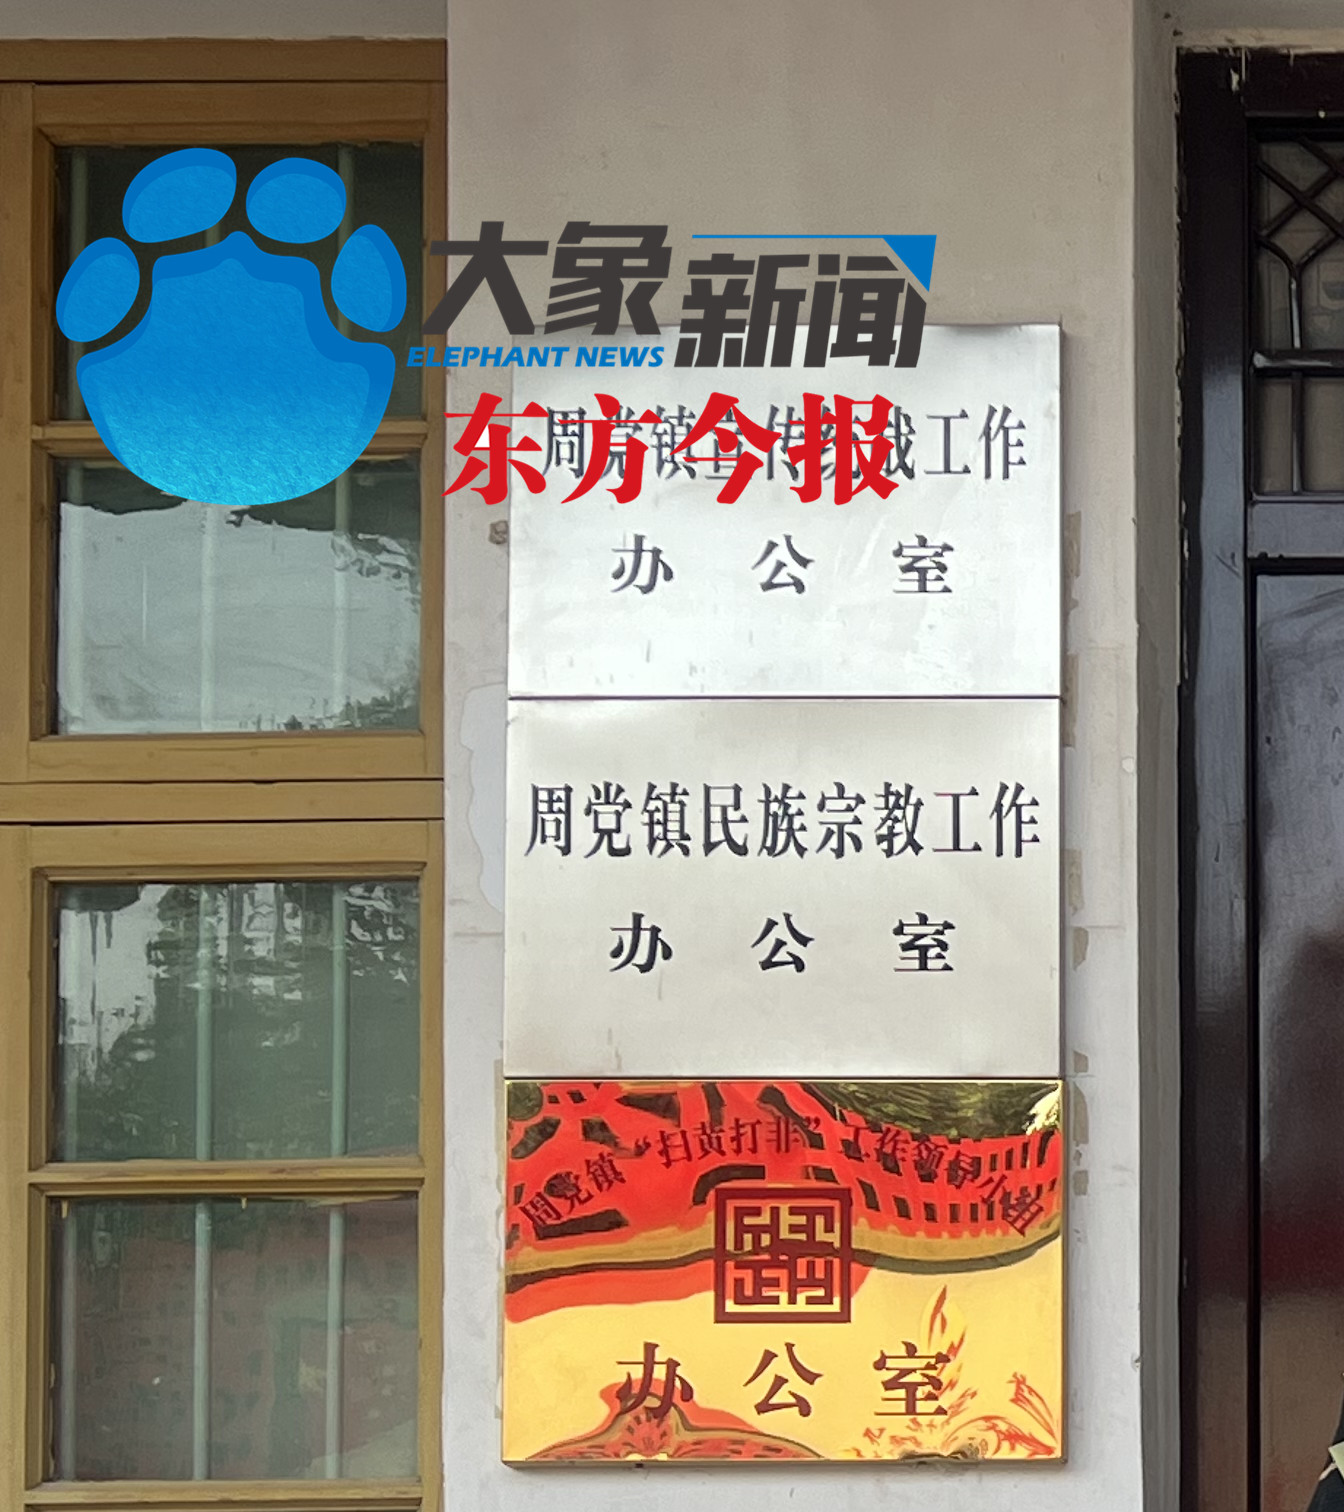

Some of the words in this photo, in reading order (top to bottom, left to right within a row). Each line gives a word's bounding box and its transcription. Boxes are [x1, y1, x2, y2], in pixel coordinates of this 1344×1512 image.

[611, 534, 955, 595] 办公室
[524, 781, 1041, 859] 周党镇民族宗教工作
[609, 912, 956, 974] 办公室
[615, 1342, 951, 1418] 办公室
